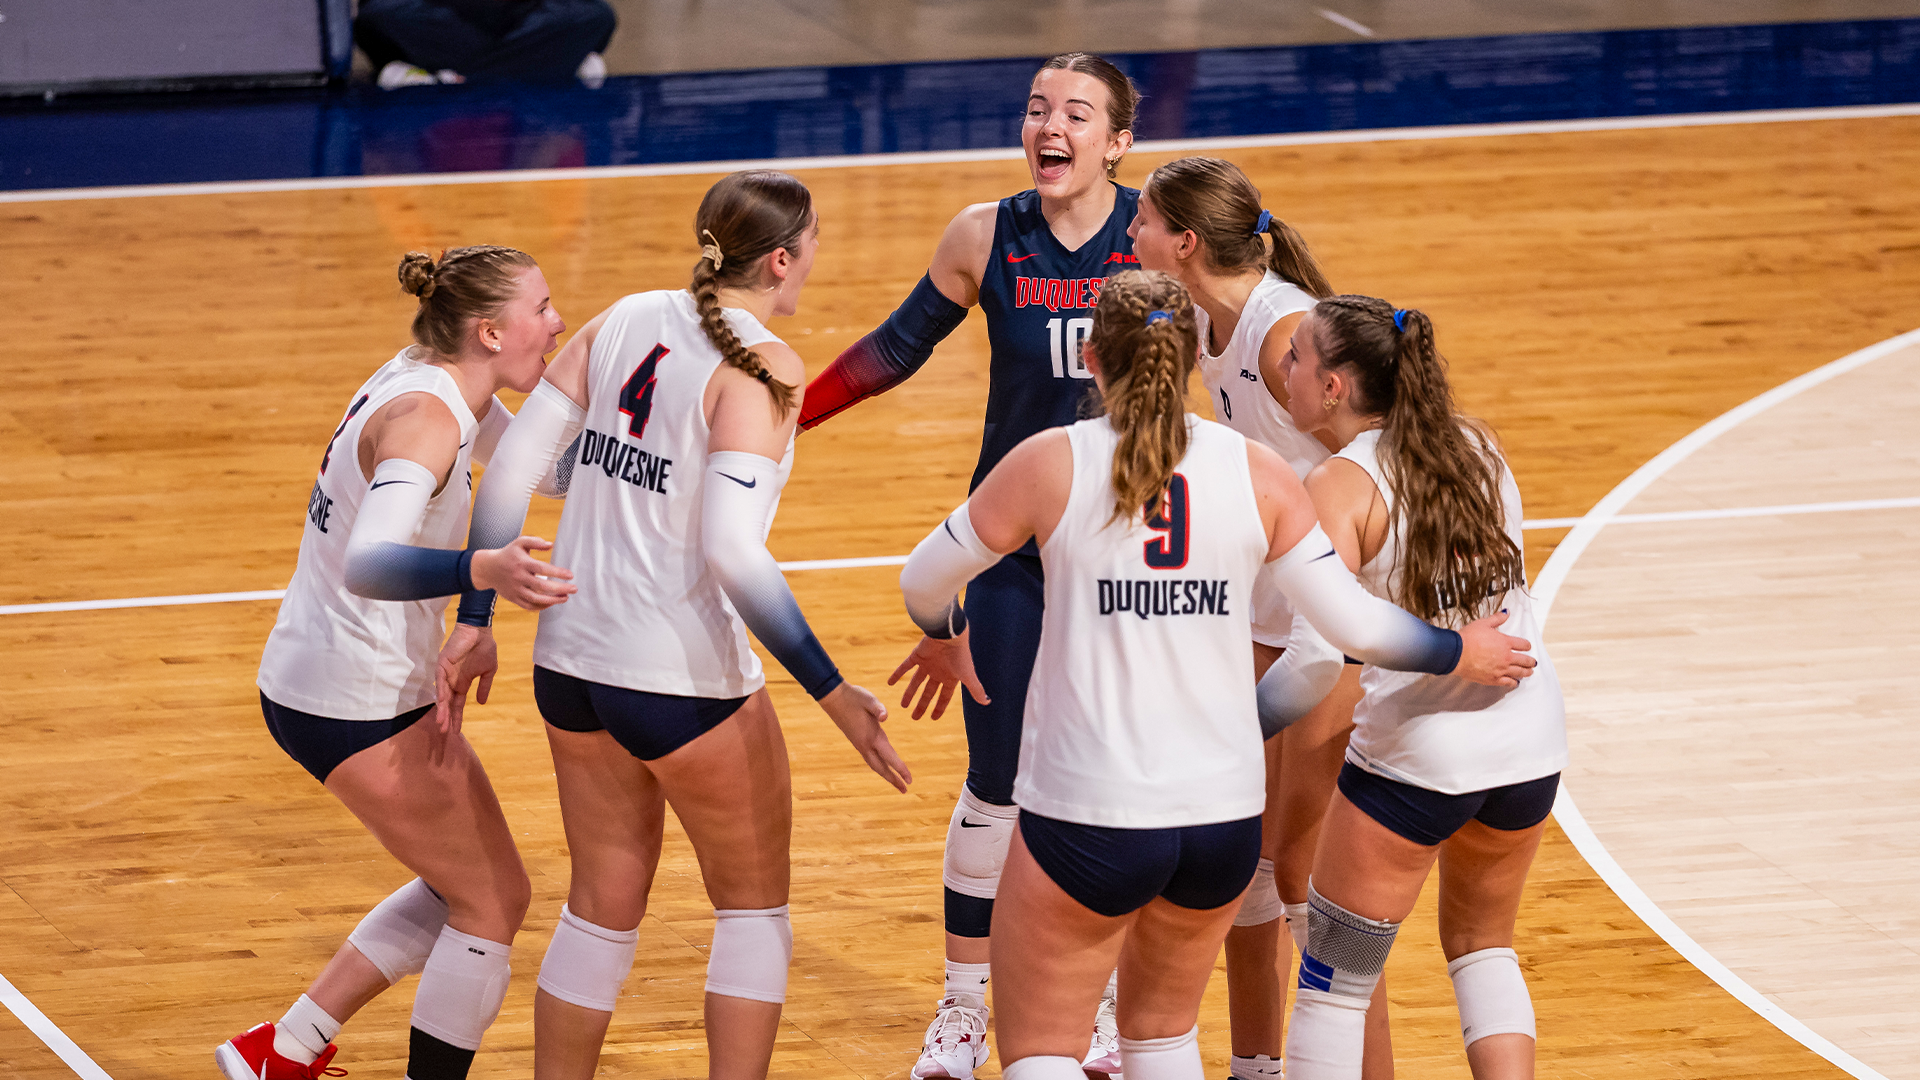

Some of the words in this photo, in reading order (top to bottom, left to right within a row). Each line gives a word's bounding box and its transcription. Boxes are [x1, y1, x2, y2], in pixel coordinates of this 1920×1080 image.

[1046, 318, 1094, 379] 10
[619, 342, 671, 440] 4
[581, 428, 673, 495] DUQUESNE
[1143, 472, 1190, 570] 9
[1097, 579, 1230, 620] DUQUESNE
